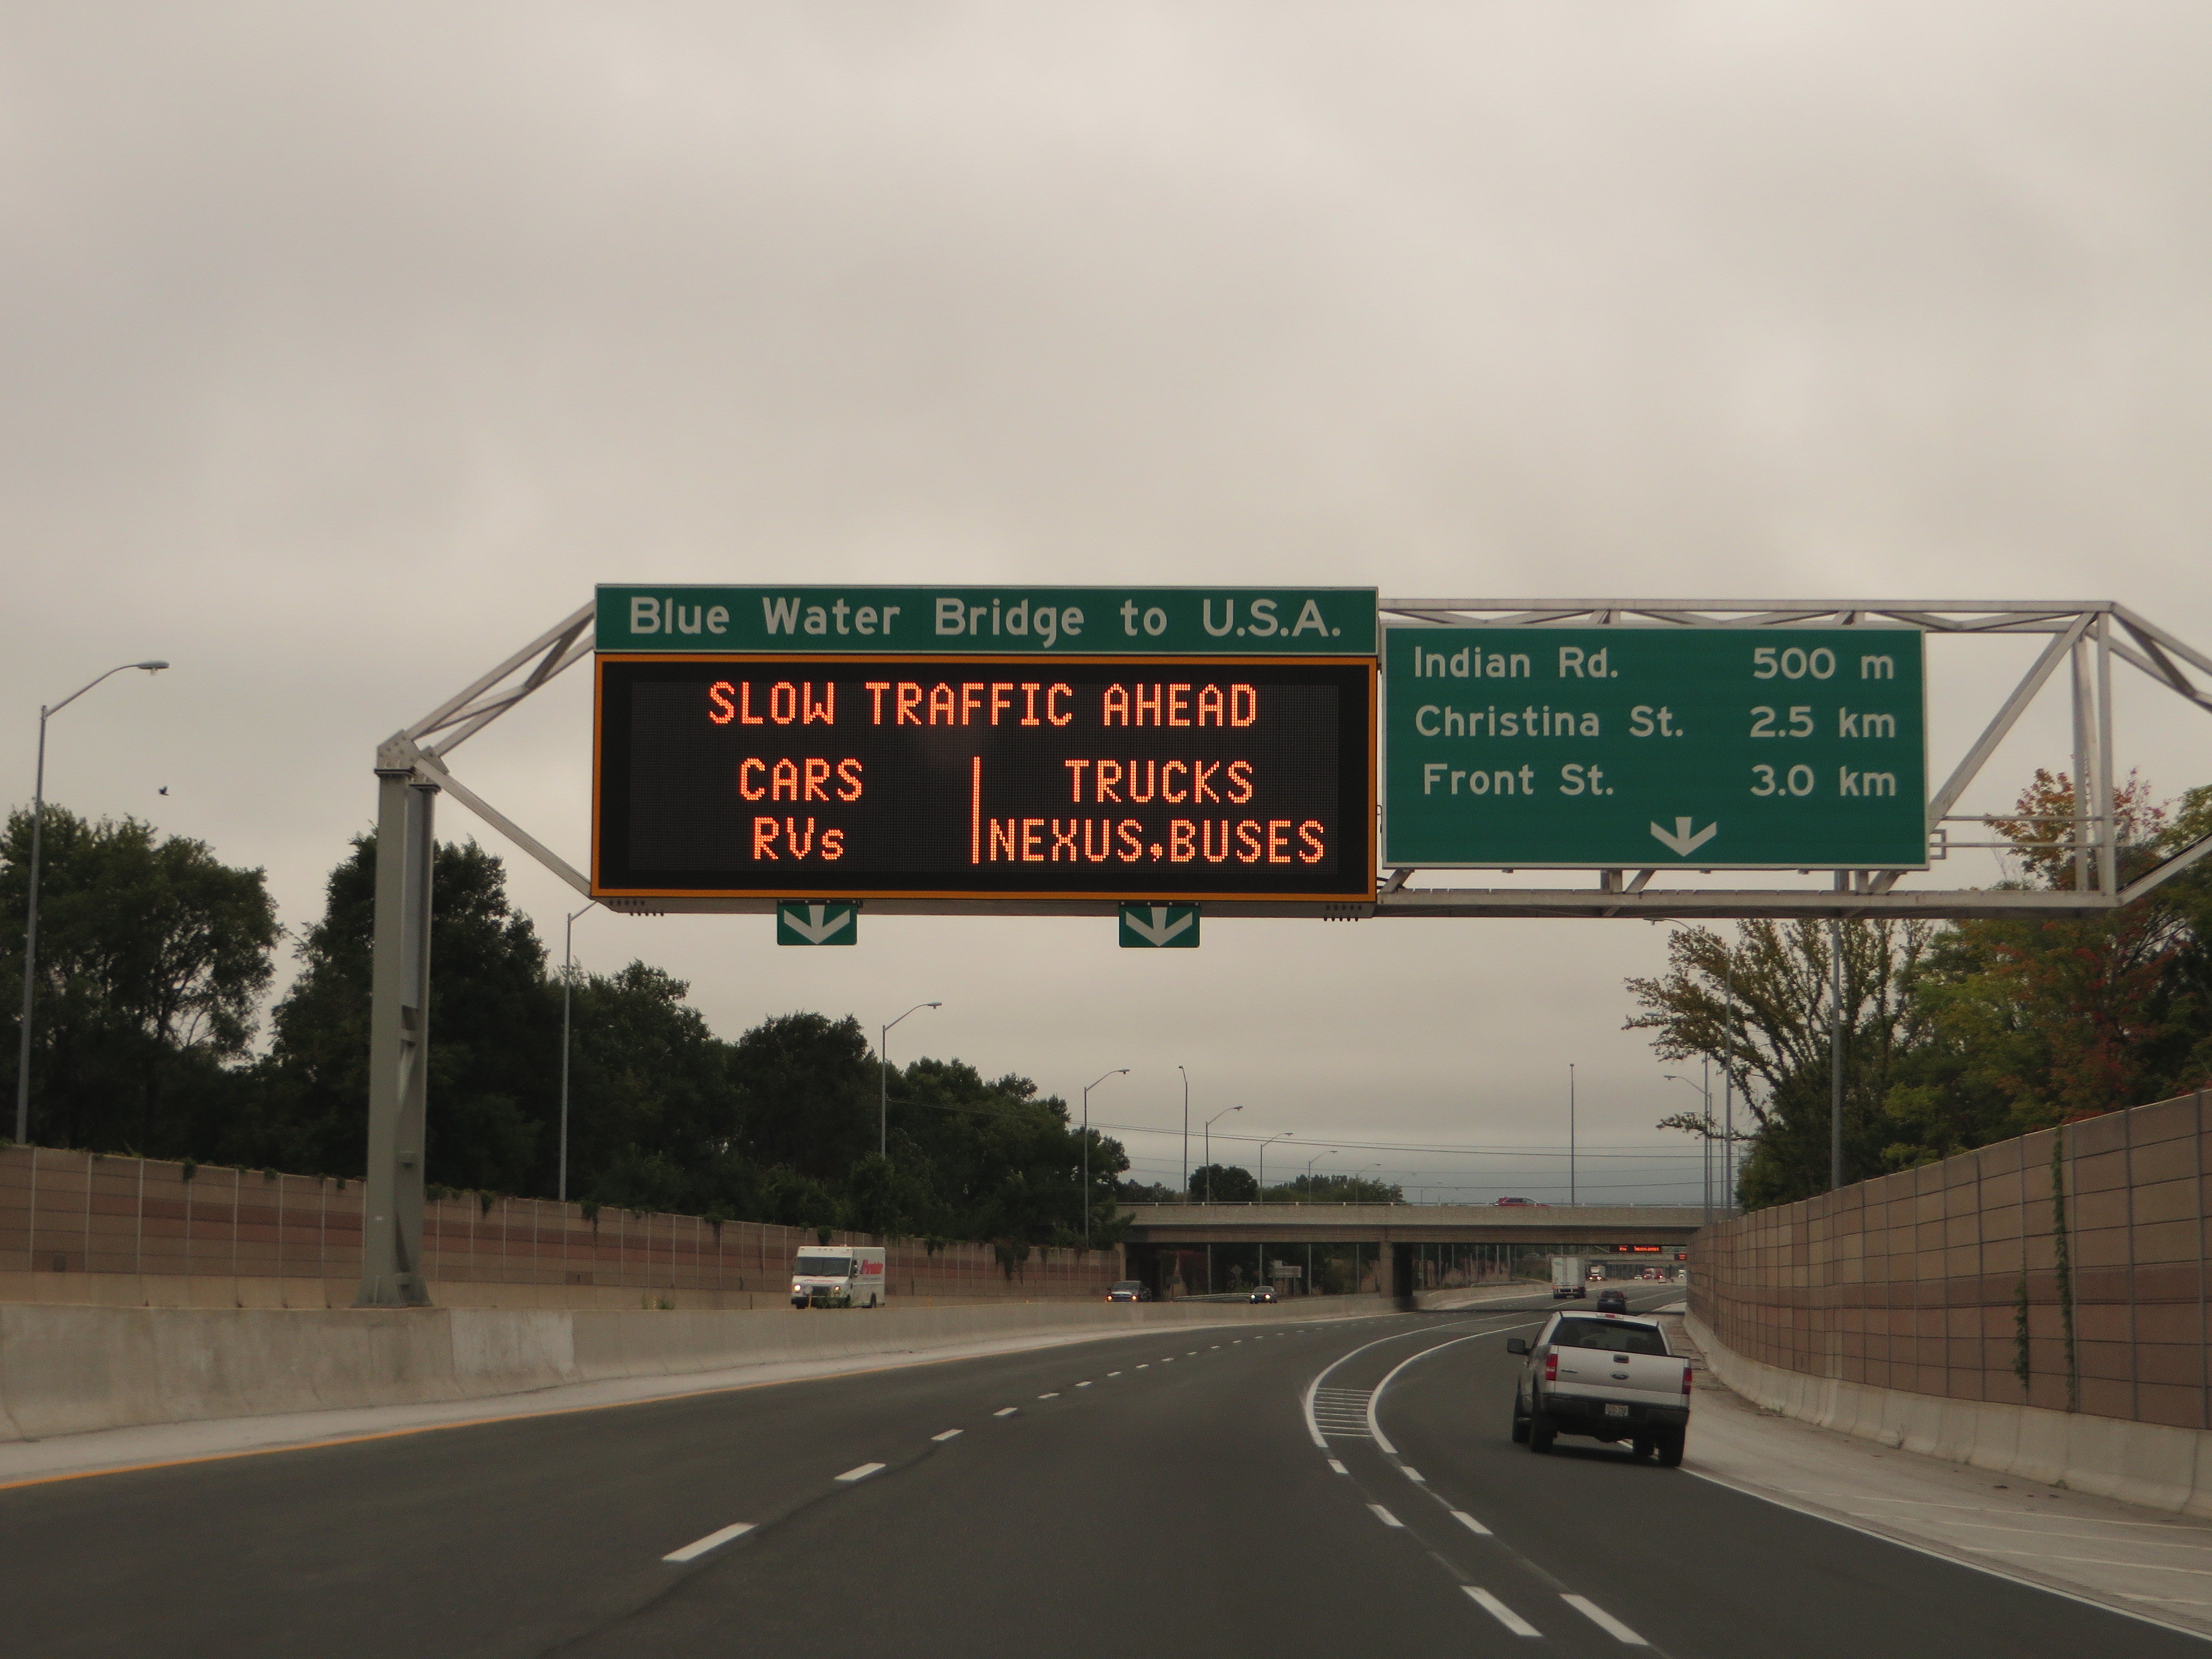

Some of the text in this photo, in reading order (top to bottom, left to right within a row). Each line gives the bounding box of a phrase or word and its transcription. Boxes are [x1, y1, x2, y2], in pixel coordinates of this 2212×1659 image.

[630, 597, 1341, 648] Blue Water Bridge to U.S.A.
[1414, 646, 1618, 678] Indian Rd.
[1753, 647, 1894, 680] 500 m
[709, 681, 1256, 727] SLOW TRAFFIC AHEAD
[1415, 705, 1683, 737] Christina St.
[1750, 706, 1896, 738] 2.5 km
[739, 758, 863, 801] CARS
[1065, 759, 1253, 804] TRUCKS
[1424, 763, 1614, 796] Front St.
[1750, 764, 1896, 797] 3.0 km
[754, 817, 845, 860] RVs
[989, 818, 1324, 863] NEXUS,BUSES
